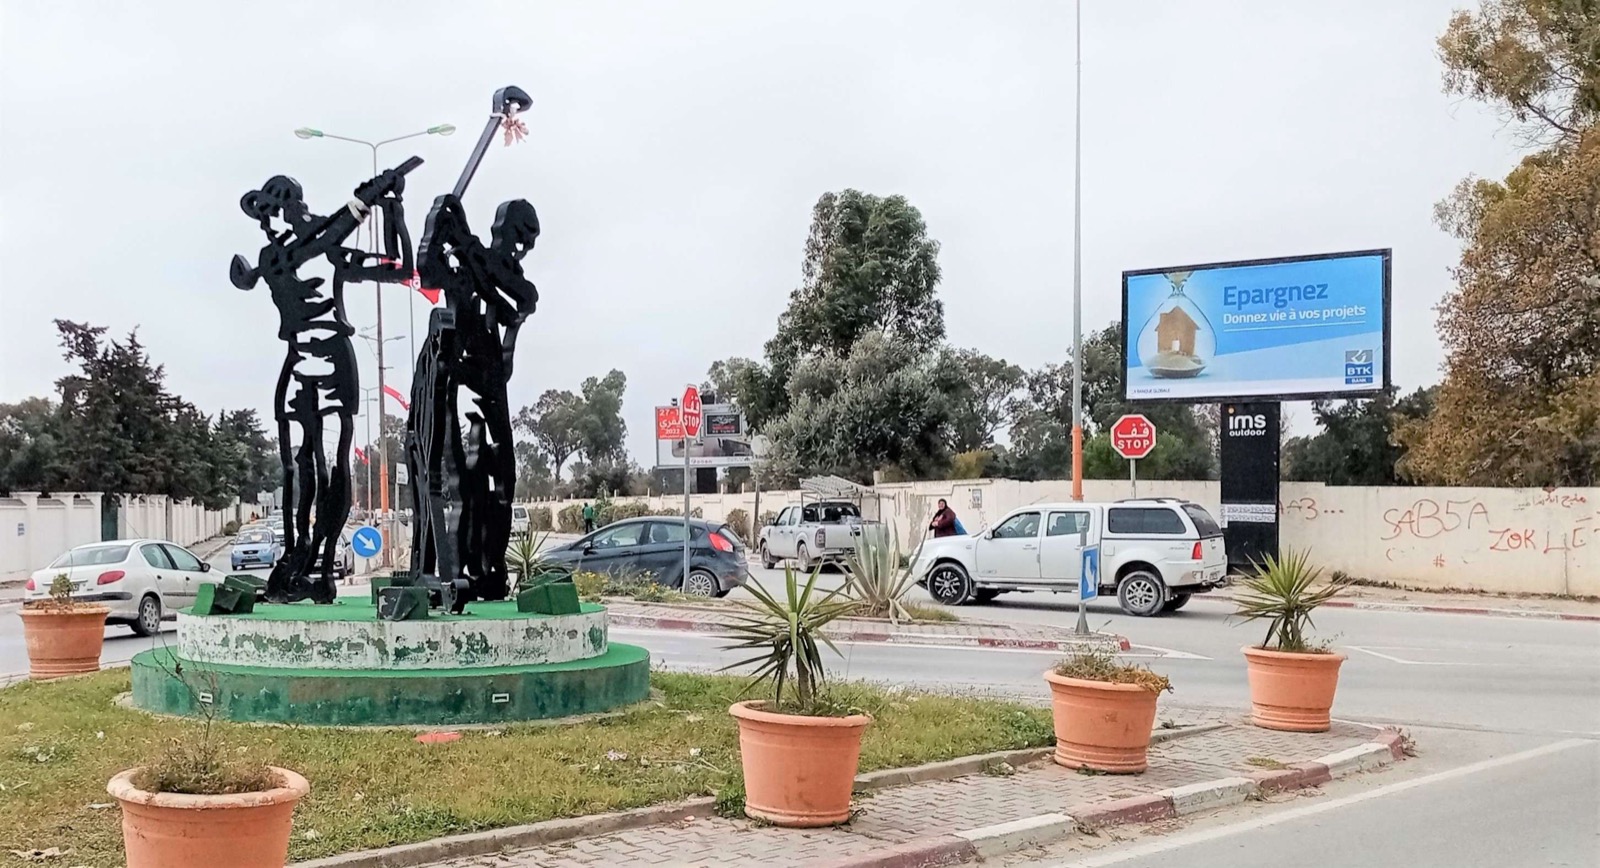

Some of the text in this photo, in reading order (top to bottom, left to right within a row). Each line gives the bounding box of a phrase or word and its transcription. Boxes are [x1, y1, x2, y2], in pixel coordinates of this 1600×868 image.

[1223, 283, 1329, 311] Epargnez
[1223, 304, 1366, 324] Donnez vie à vos projets
[1347, 366, 1372, 376] BTK
[684, 414, 699, 428] STOP
[1228, 407, 1267, 429] ims
[1117, 422, 1149, 438] قف
[1229, 429, 1266, 437] outdoor
[1117, 439, 1150, 449] STOP
